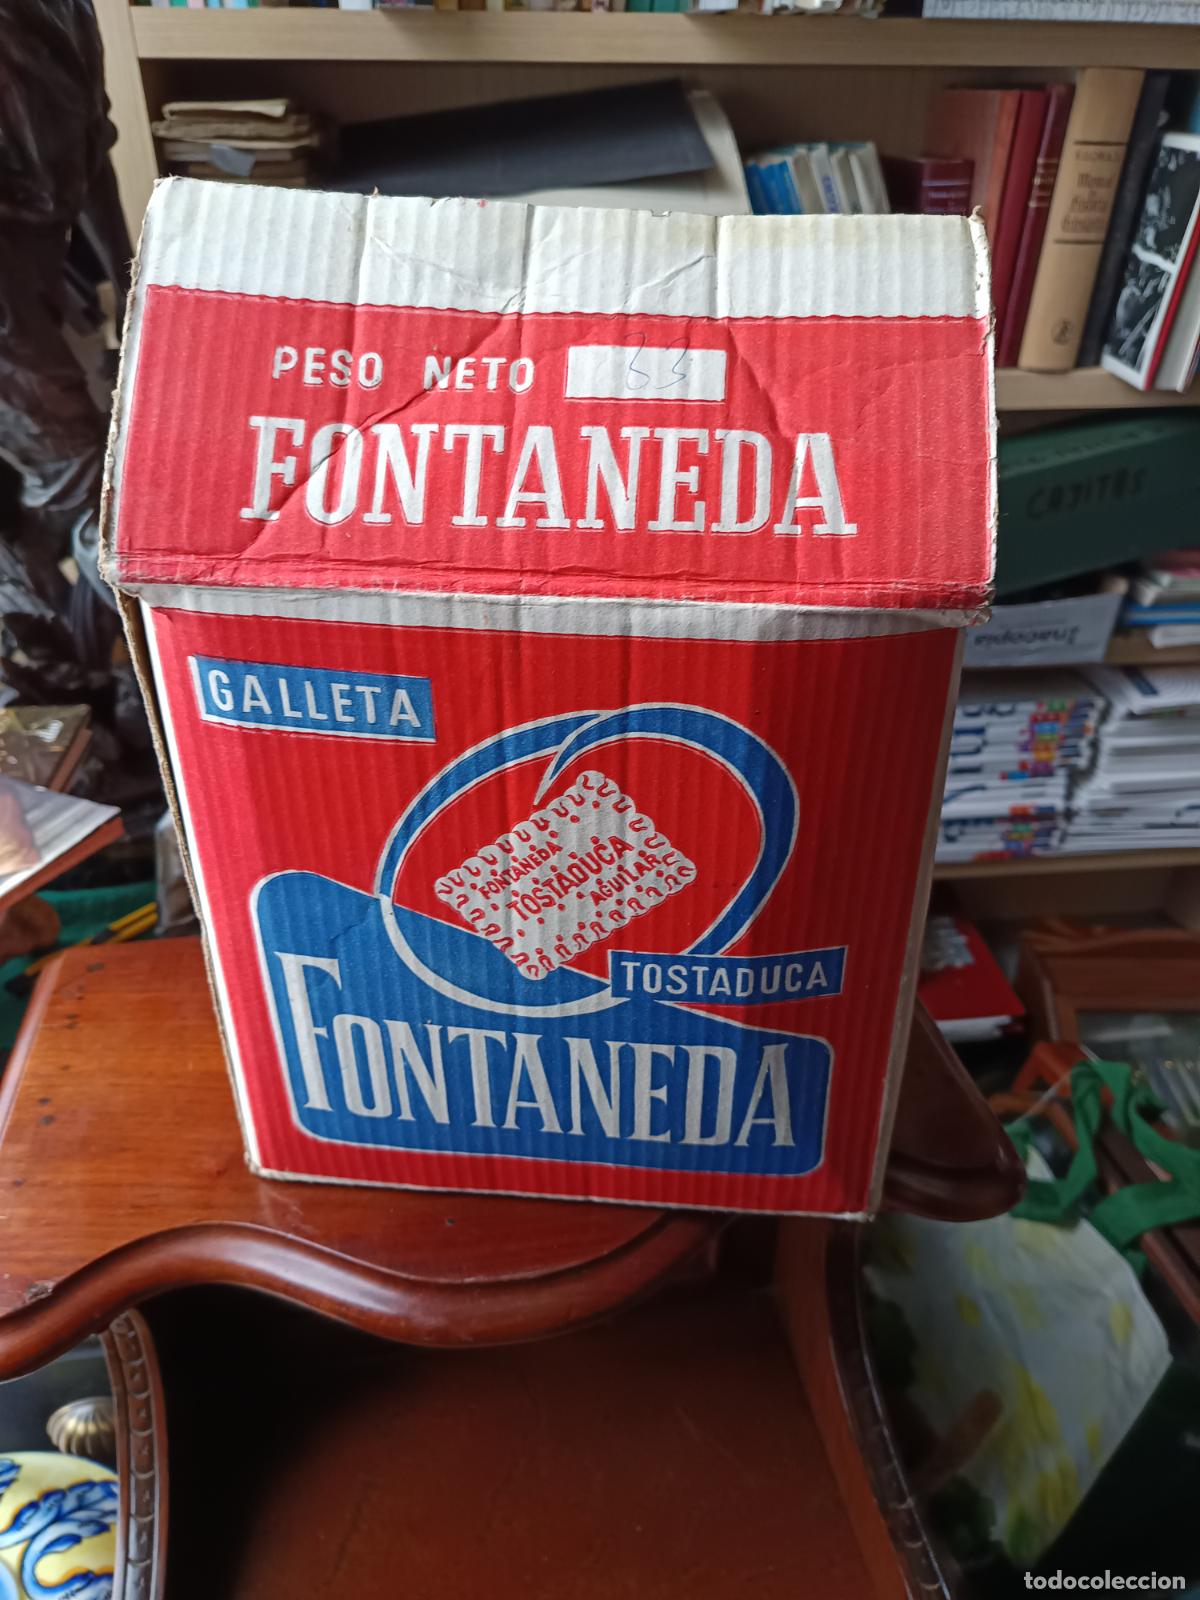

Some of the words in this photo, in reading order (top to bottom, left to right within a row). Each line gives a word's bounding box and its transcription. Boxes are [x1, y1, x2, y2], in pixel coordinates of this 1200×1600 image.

[272, 345, 384, 389] PESO
[423, 355, 535, 392] NETO
[239, 415, 858, 536] FONTANEDA
[207, 669, 421, 728] GALLETA
[478, 840, 564, 900] FONTANEDA
[506, 835, 636, 922] TOSTADUCA
[589, 852, 663, 907] AGUILAR
[620, 960, 828, 998] TOSTADUCA
[273, 950, 797, 1148] FONTANEDA
